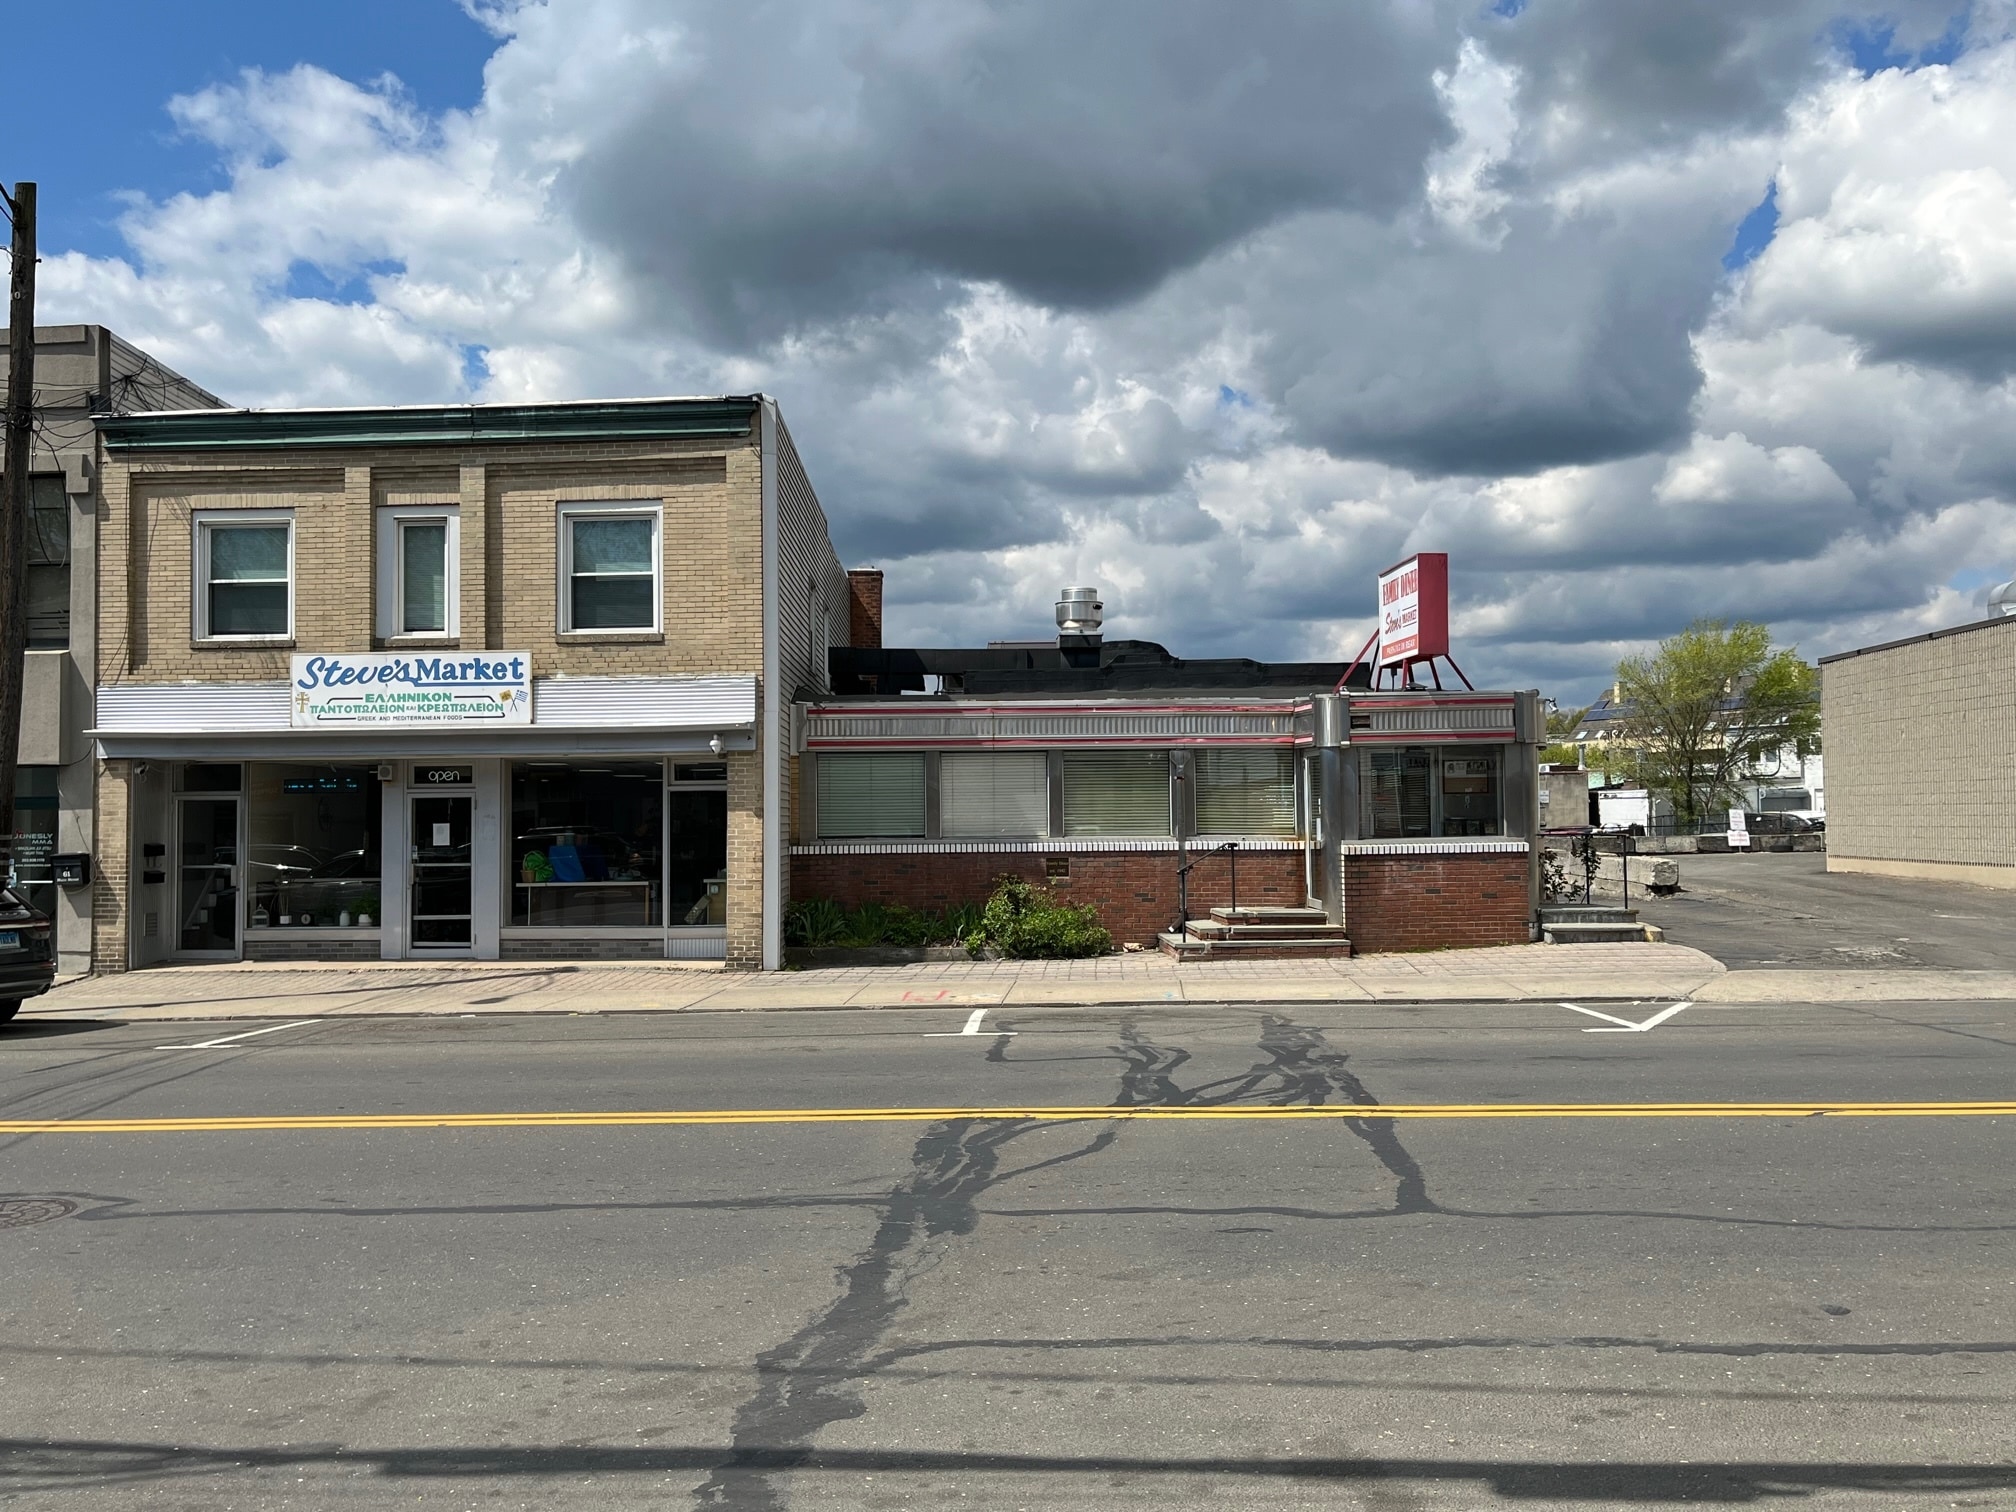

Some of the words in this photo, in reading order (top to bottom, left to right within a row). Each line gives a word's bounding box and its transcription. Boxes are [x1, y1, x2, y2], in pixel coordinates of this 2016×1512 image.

[297, 656, 410, 690] Steve's
[414, 657, 524, 681] Market
[364, 692, 452, 703] ΕΛΛΗΝΙΚΟΝ
[310, 704, 405, 714] ΠΑΝΤΟΠΩΛΕΙΟΝ
[417, 703, 504, 713] ΚΡΕΩΠΩΛΕΙΟΝ
[428, 770, 460, 784] open
